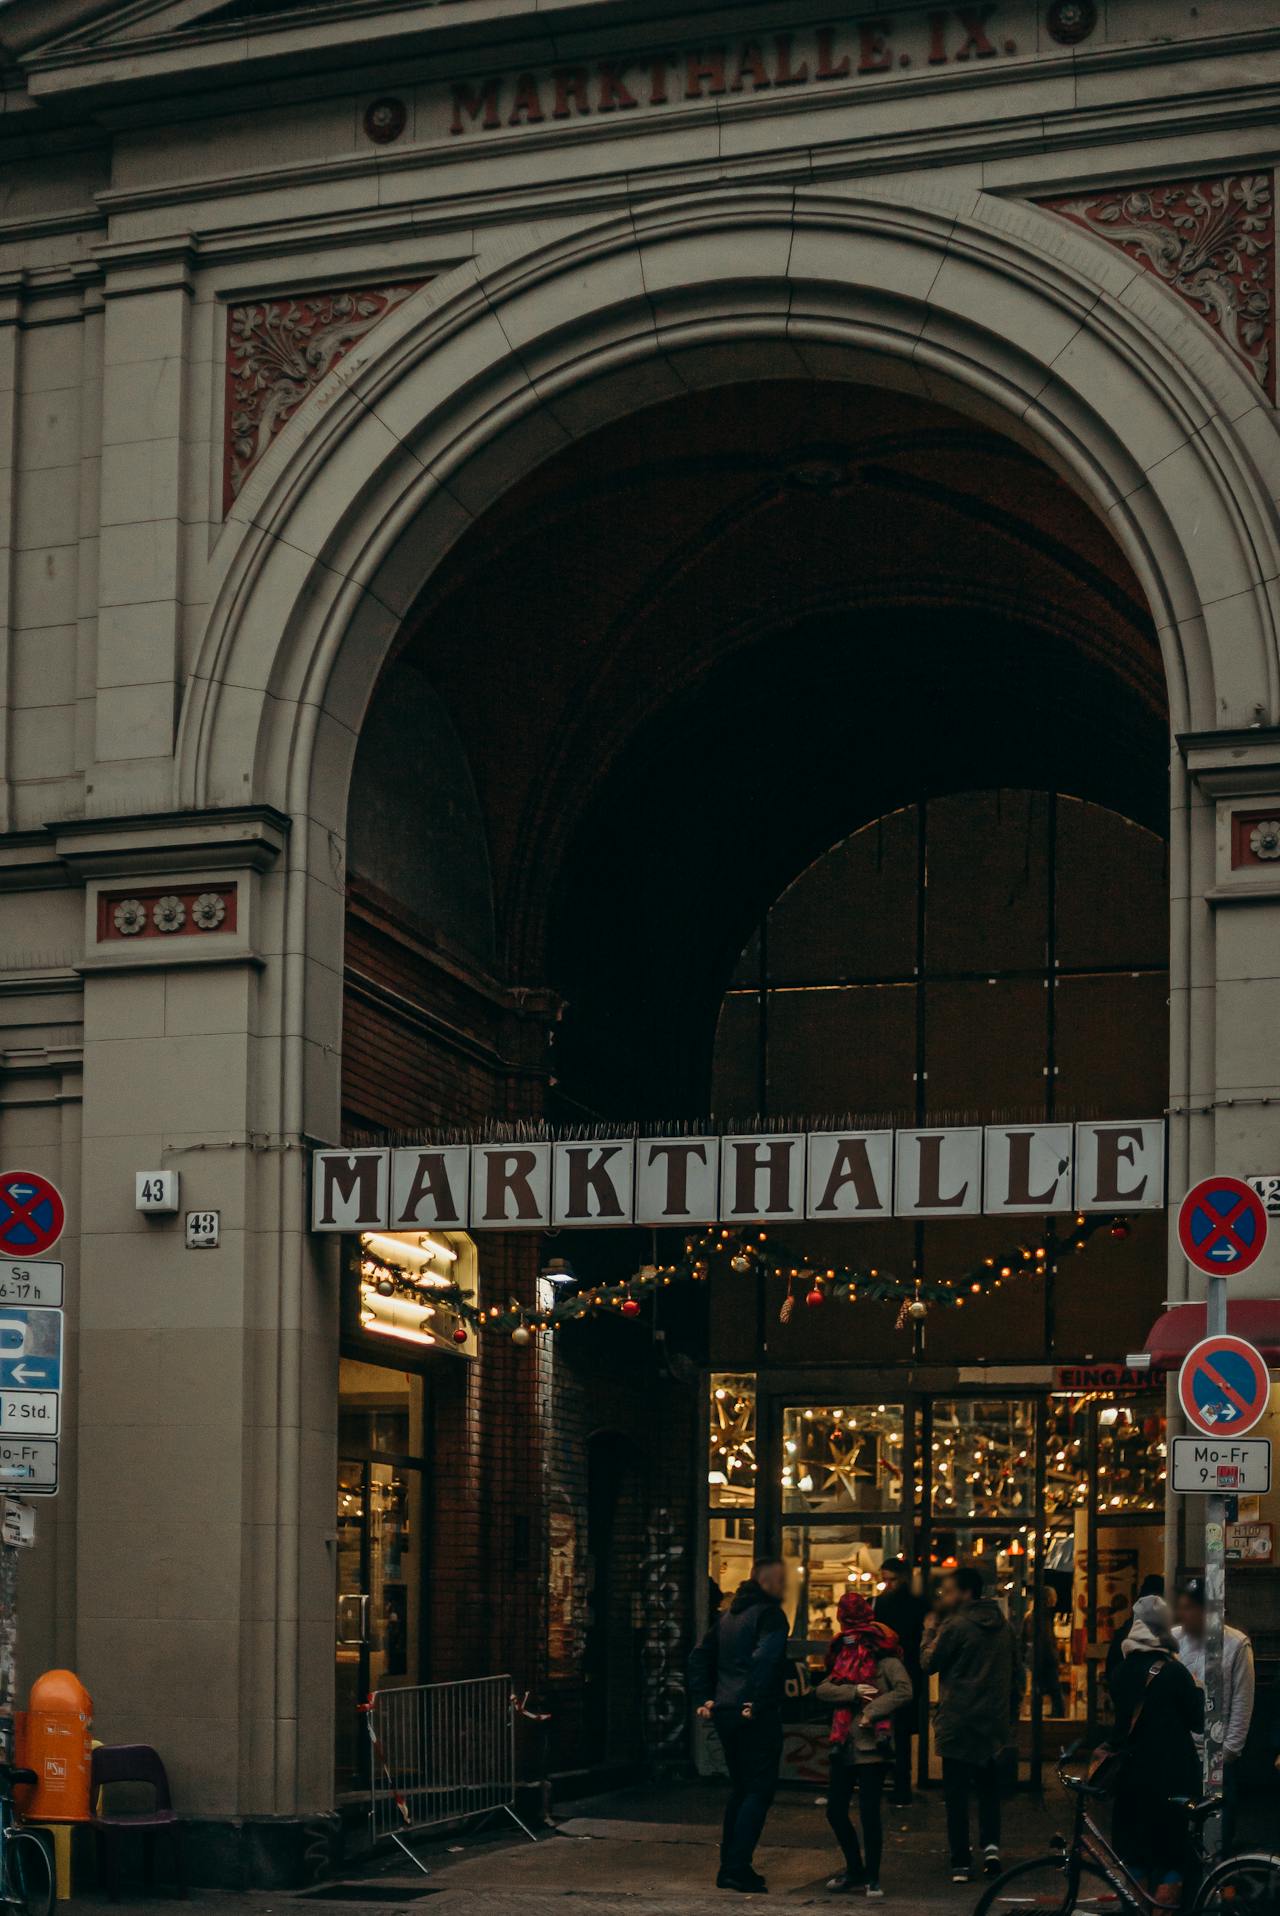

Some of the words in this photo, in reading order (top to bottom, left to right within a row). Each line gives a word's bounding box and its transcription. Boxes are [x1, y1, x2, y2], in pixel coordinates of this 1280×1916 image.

[926, 5, 1017, 65] IX.
[322, 1127, 1149, 1224] MARKTHALLE
[141, 1179, 164, 1203] 43
[190, 1213, 215, 1235] 43
[11, 1267, 30, 1281] Sa
[34, 1286, 41, 1299] h
[8, 1404, 16, 1417] 2
[20, 1405, 51, 1419] Std.
[0, 1446, 39, 1460] o-Fr
[1194, 1447, 1249, 1463] Mo-Fr
